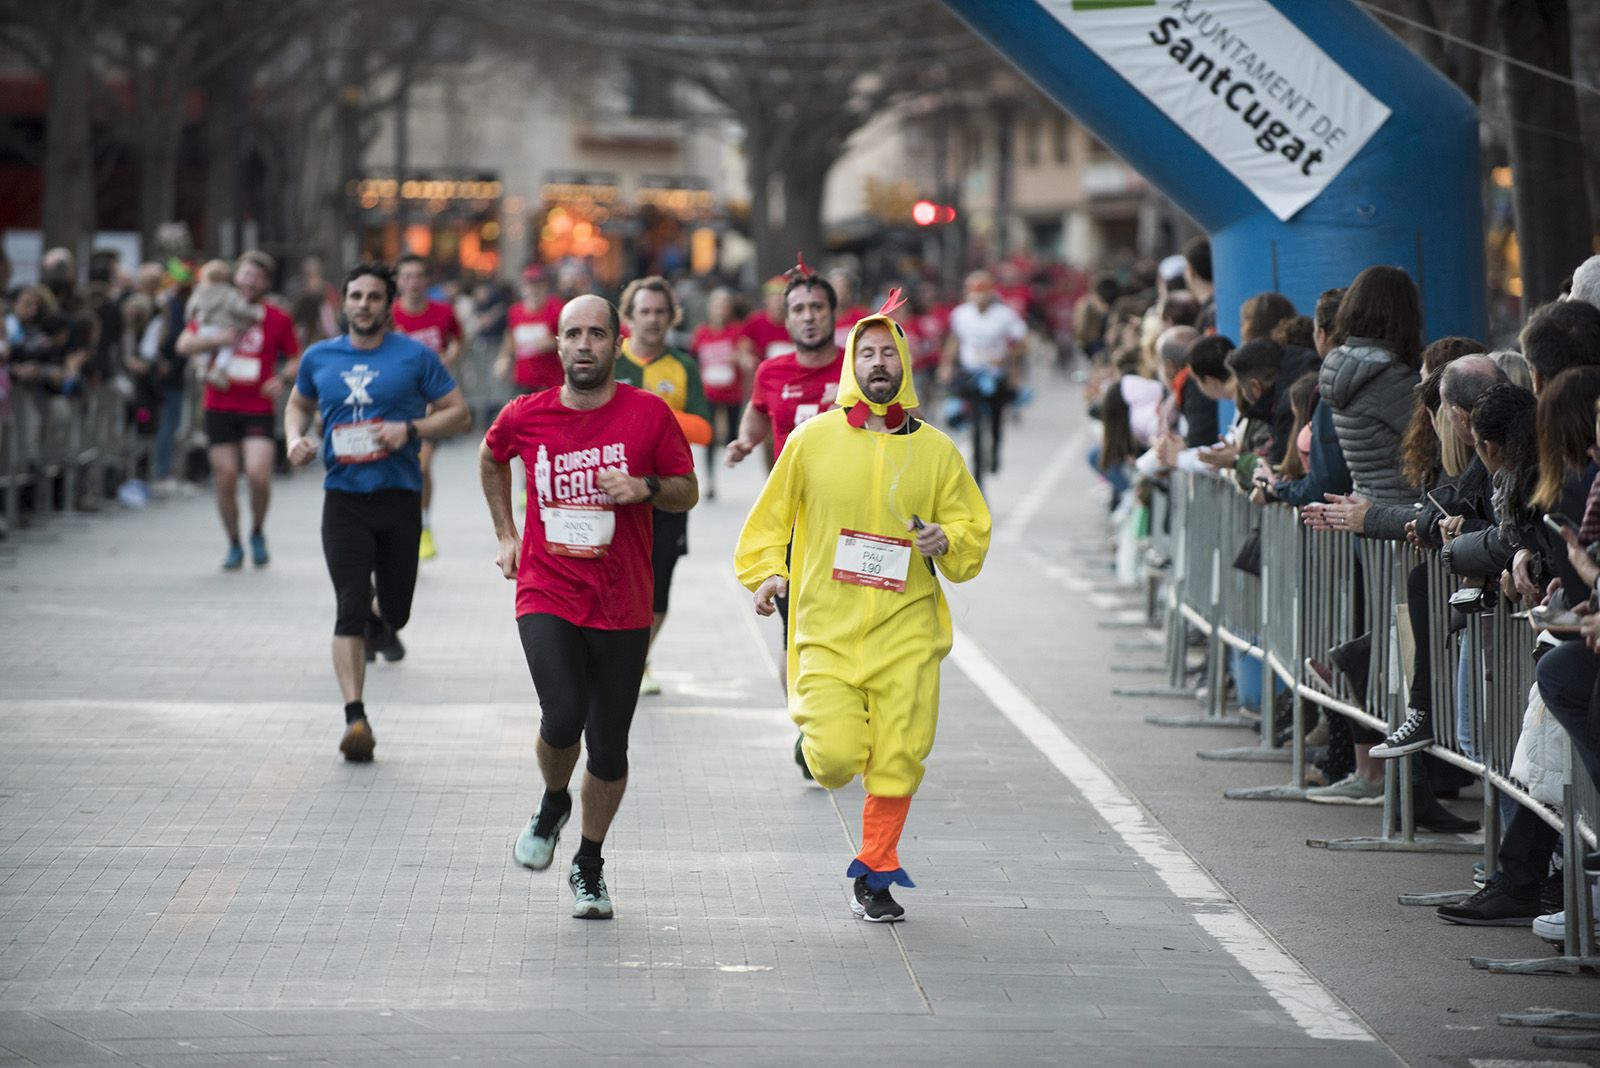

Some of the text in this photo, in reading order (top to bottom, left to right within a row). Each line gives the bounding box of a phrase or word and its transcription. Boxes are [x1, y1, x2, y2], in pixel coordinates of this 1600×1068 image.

[1171, 0, 1347, 150] AJUNTAMENT DE
[1149, 17, 1323, 177] SantCugat
[554, 442, 628, 473] CURSA DEL
[861, 562, 882, 575] 190
[862, 551, 884, 563] PAU
